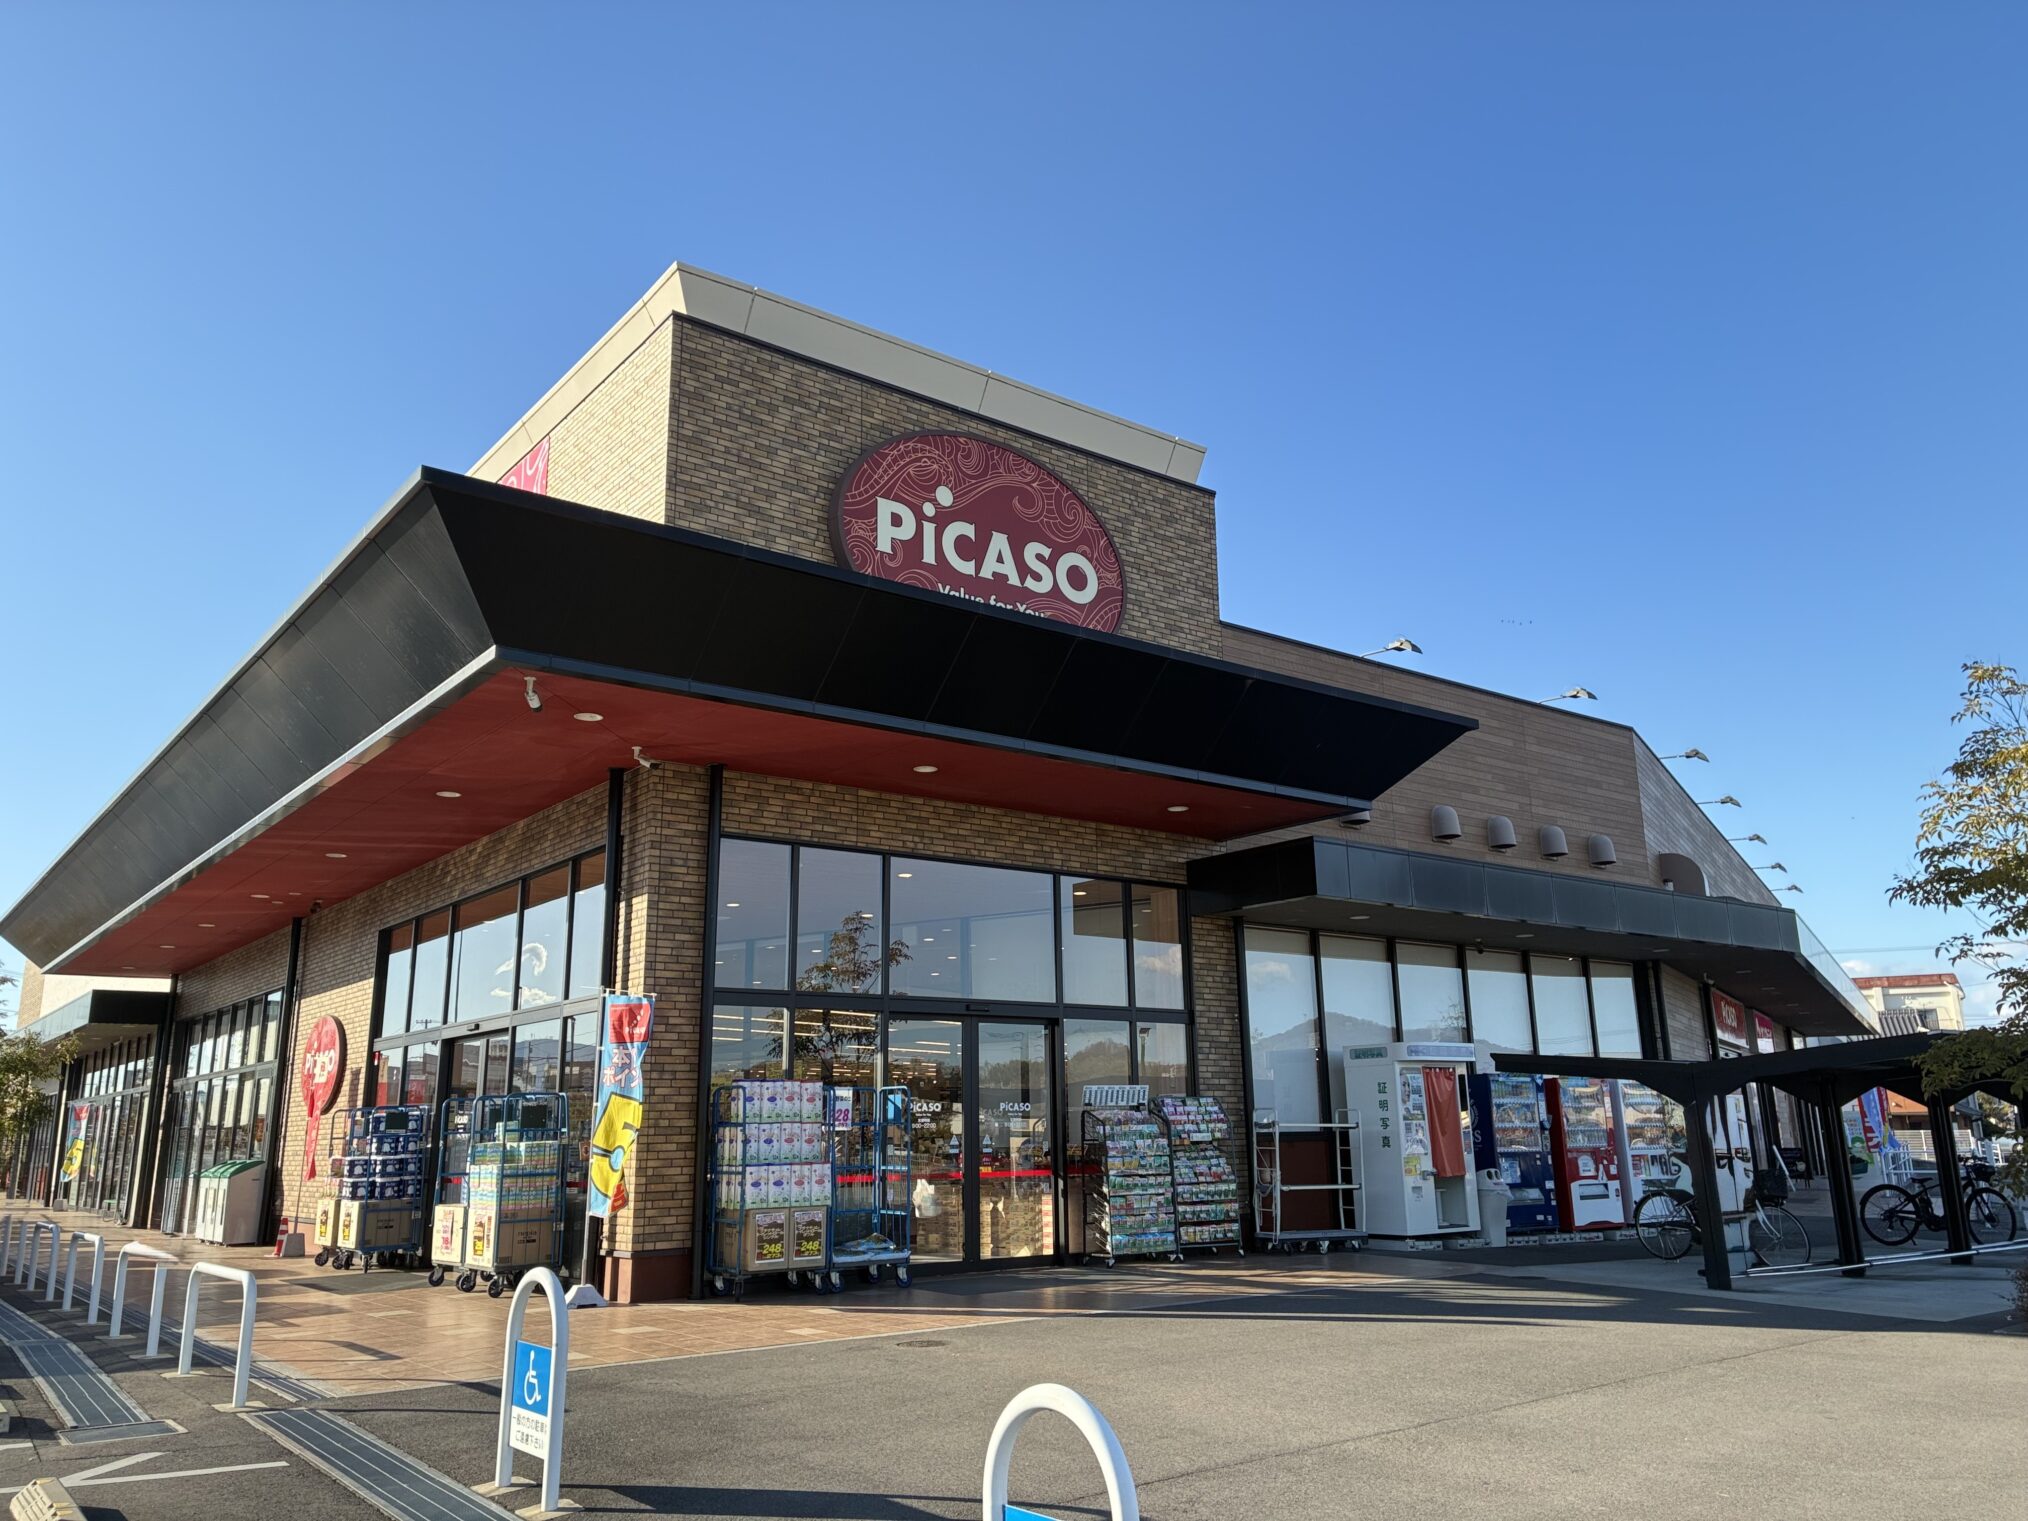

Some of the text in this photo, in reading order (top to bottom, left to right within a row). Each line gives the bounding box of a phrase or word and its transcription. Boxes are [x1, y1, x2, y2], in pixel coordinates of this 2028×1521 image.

[875, 489, 1098, 604] PiCASO
[304, 1045, 335, 1075] PiO
[1000, 1101, 1031, 1111] PiCASO
[1377, 1081, 1391, 1149] 証明写真
[763, 1244, 782, 1254] 248
[801, 1240, 820, 1252] 248
